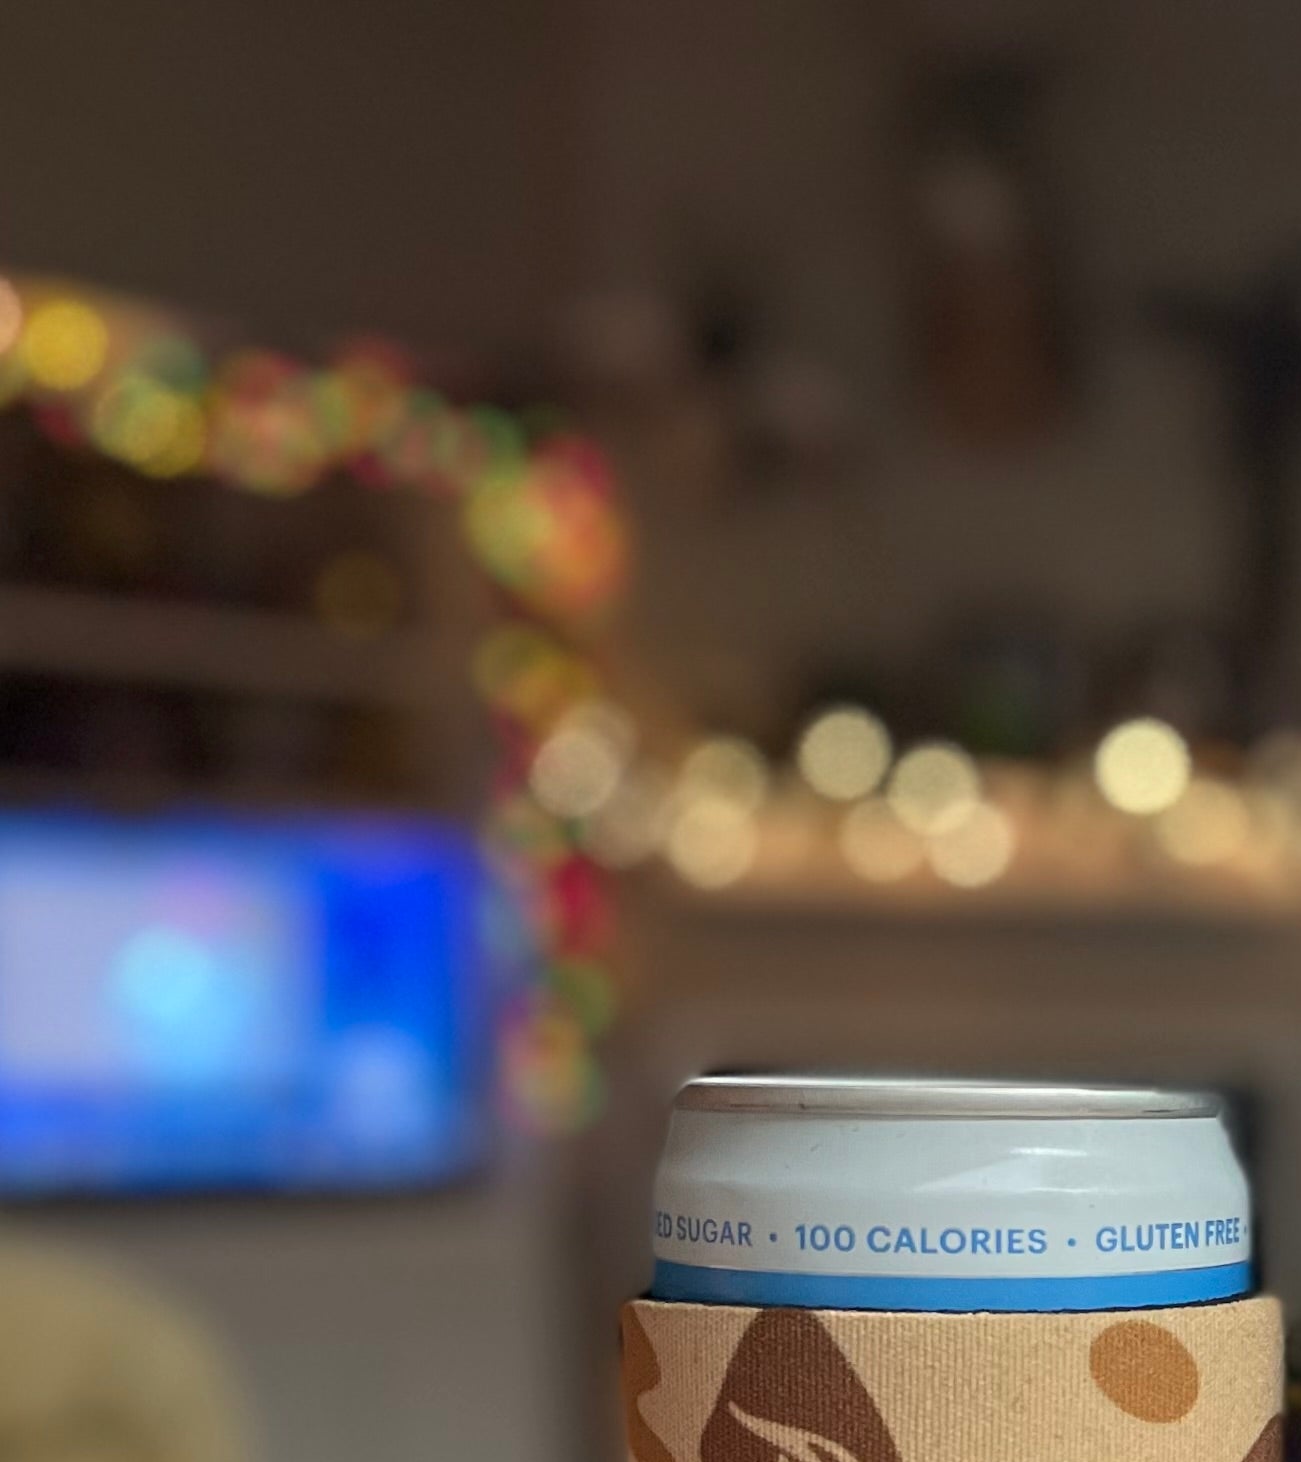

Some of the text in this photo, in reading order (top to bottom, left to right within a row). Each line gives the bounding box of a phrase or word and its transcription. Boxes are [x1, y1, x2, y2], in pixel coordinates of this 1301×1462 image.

[676, 1215, 752, 1247] SUGAR
[795, 1224, 856, 1252] 100
[866, 1225, 1047, 1254] CALORIES
[1096, 1221, 1199, 1253] GLUTEN
[1205, 1217, 1240, 1247] FREE
